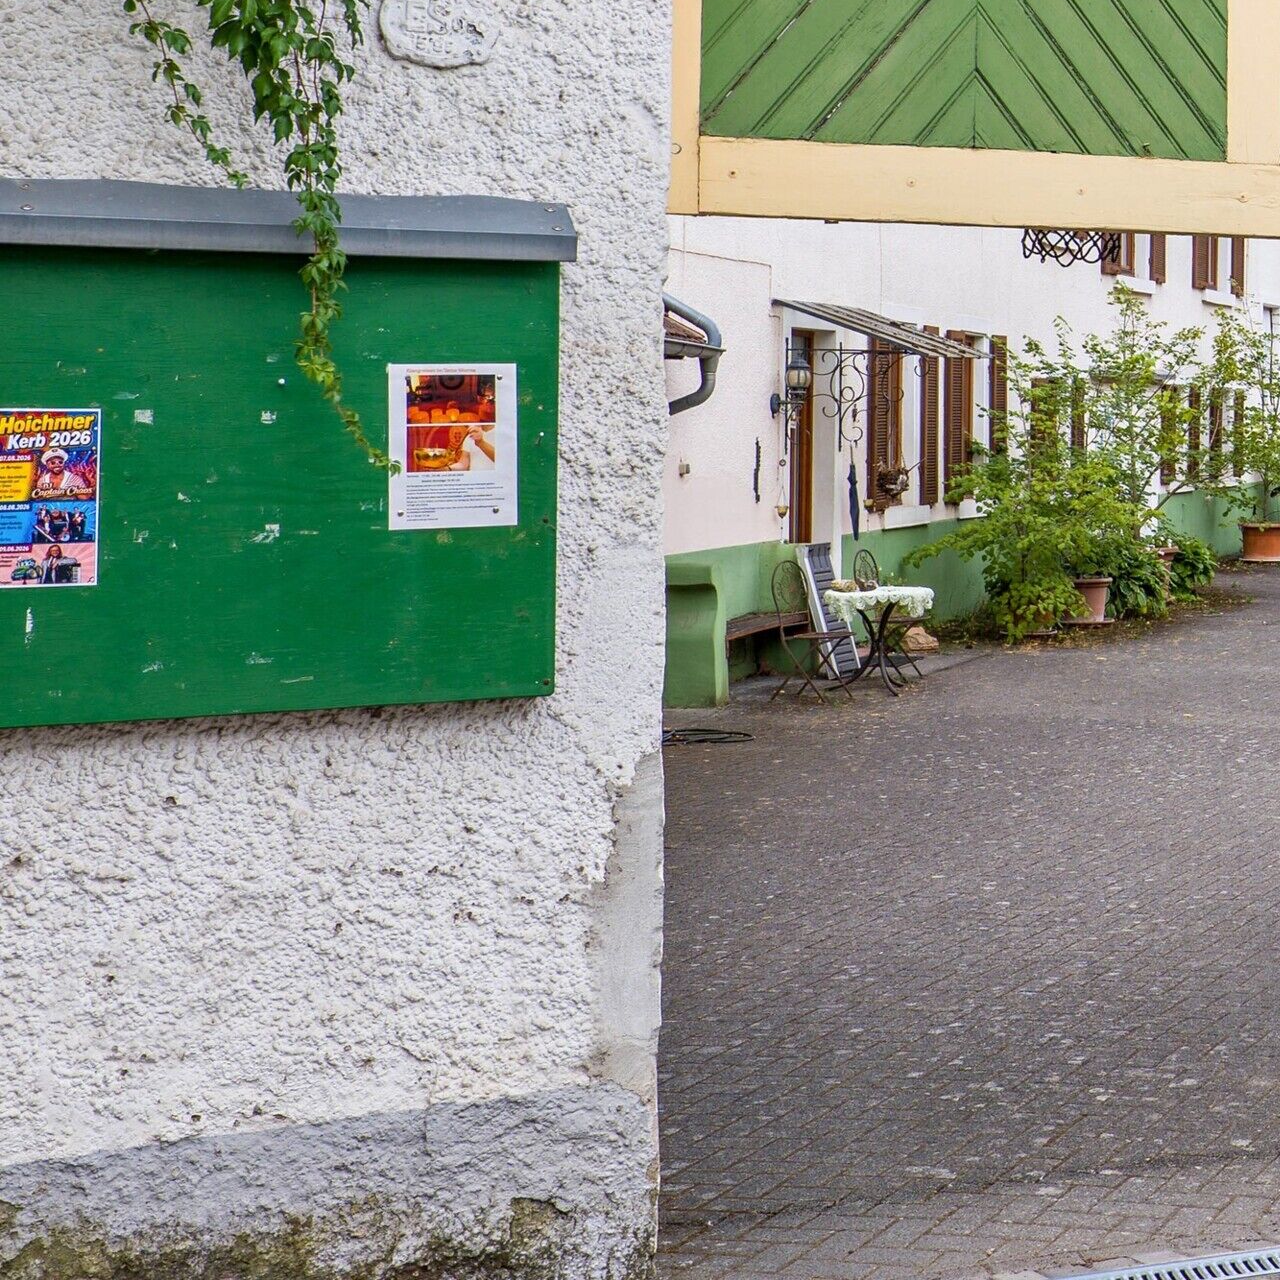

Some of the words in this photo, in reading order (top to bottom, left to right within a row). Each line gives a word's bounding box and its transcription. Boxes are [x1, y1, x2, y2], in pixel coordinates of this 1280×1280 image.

[0, 414, 95, 435] Hoichmer
[7, 433, 47, 450] Kerb
[49, 430, 92, 447] 2026
[31, 488, 65, 499] Captain
[66, 486, 93, 496] Chaos
